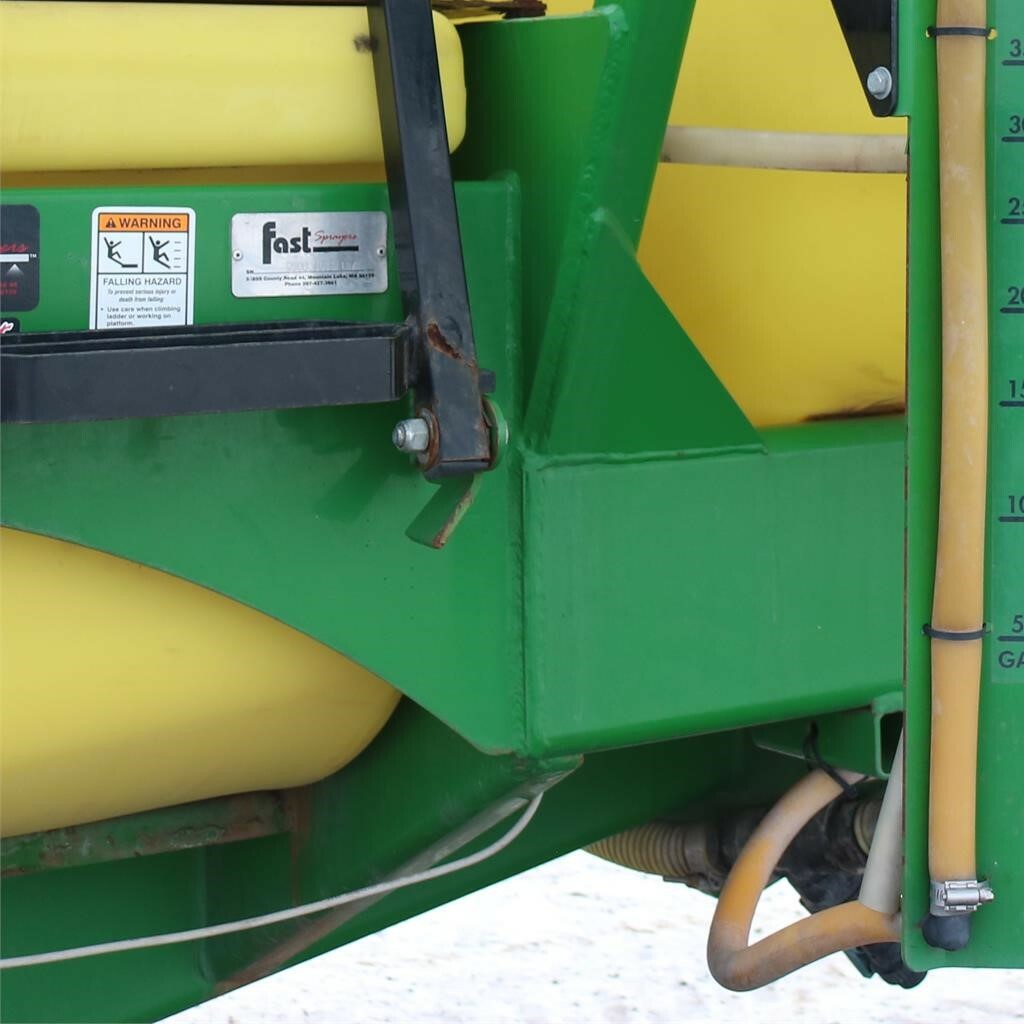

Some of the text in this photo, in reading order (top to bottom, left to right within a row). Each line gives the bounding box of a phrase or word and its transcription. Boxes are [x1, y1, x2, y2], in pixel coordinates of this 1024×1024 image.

[118, 218, 182, 229] WARNING
[262, 221, 311, 264] fast
[103, 277, 182, 286] FALLING HAZARD
